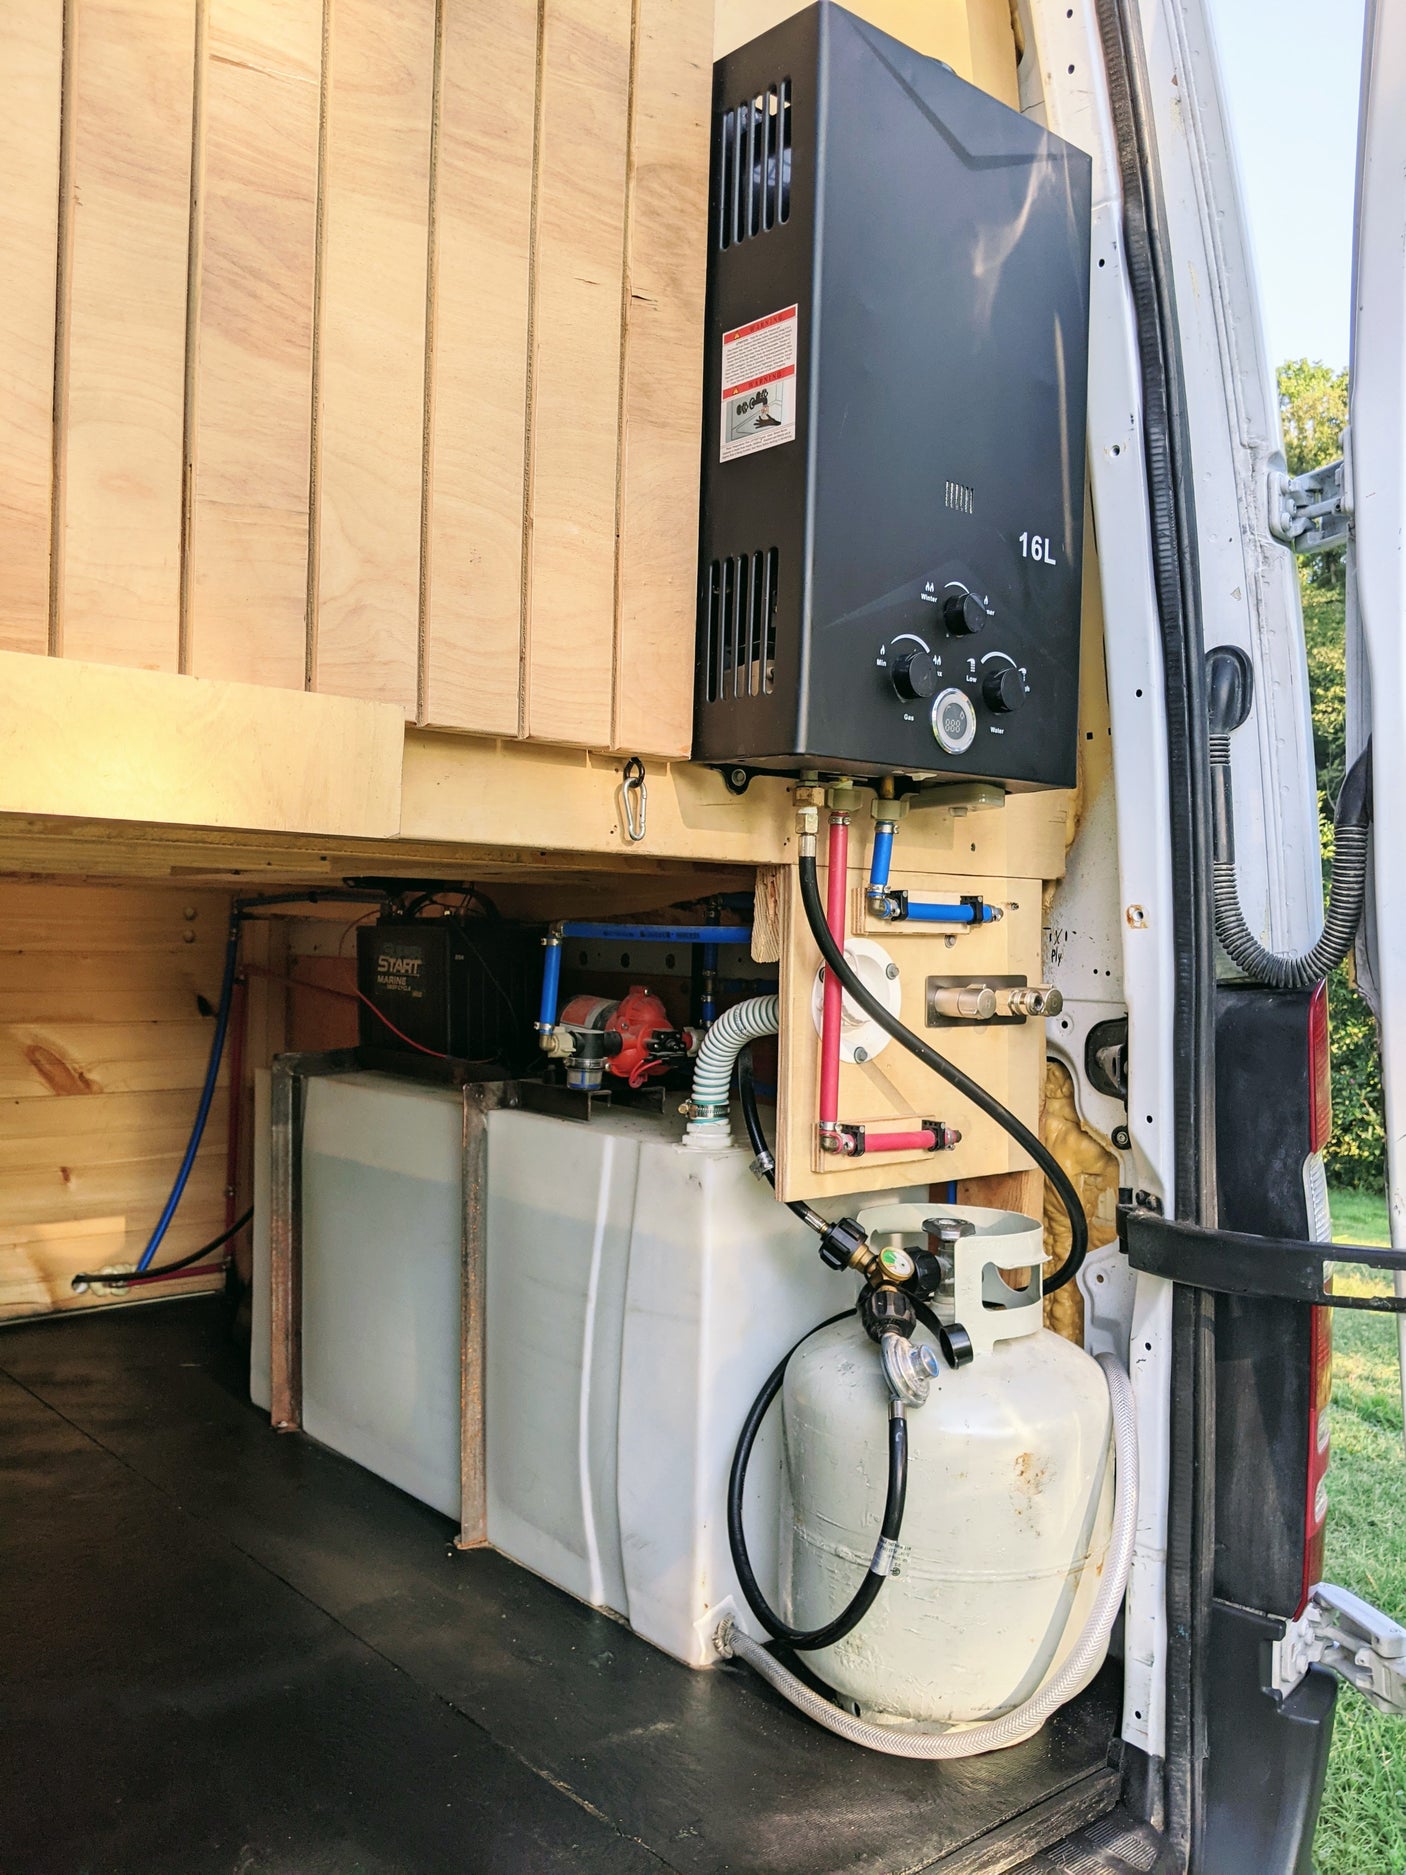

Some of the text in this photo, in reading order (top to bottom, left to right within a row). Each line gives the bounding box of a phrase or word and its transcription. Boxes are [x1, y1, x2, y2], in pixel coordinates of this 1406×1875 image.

[749, 314, 783, 332] WARNING
[749, 371, 782, 388] WARNING
[1019, 532, 1056, 565] 16L
[920, 592, 938, 603] Winter
[876, 658, 887, 667] Min
[966, 674, 977, 683] Low
[903, 713, 915, 721] Gas
[990, 726, 1004, 735] Water
[1051, 946, 1063, 967] Ply
[377, 955, 422, 974] START
[377, 975, 407, 986] MARINE
